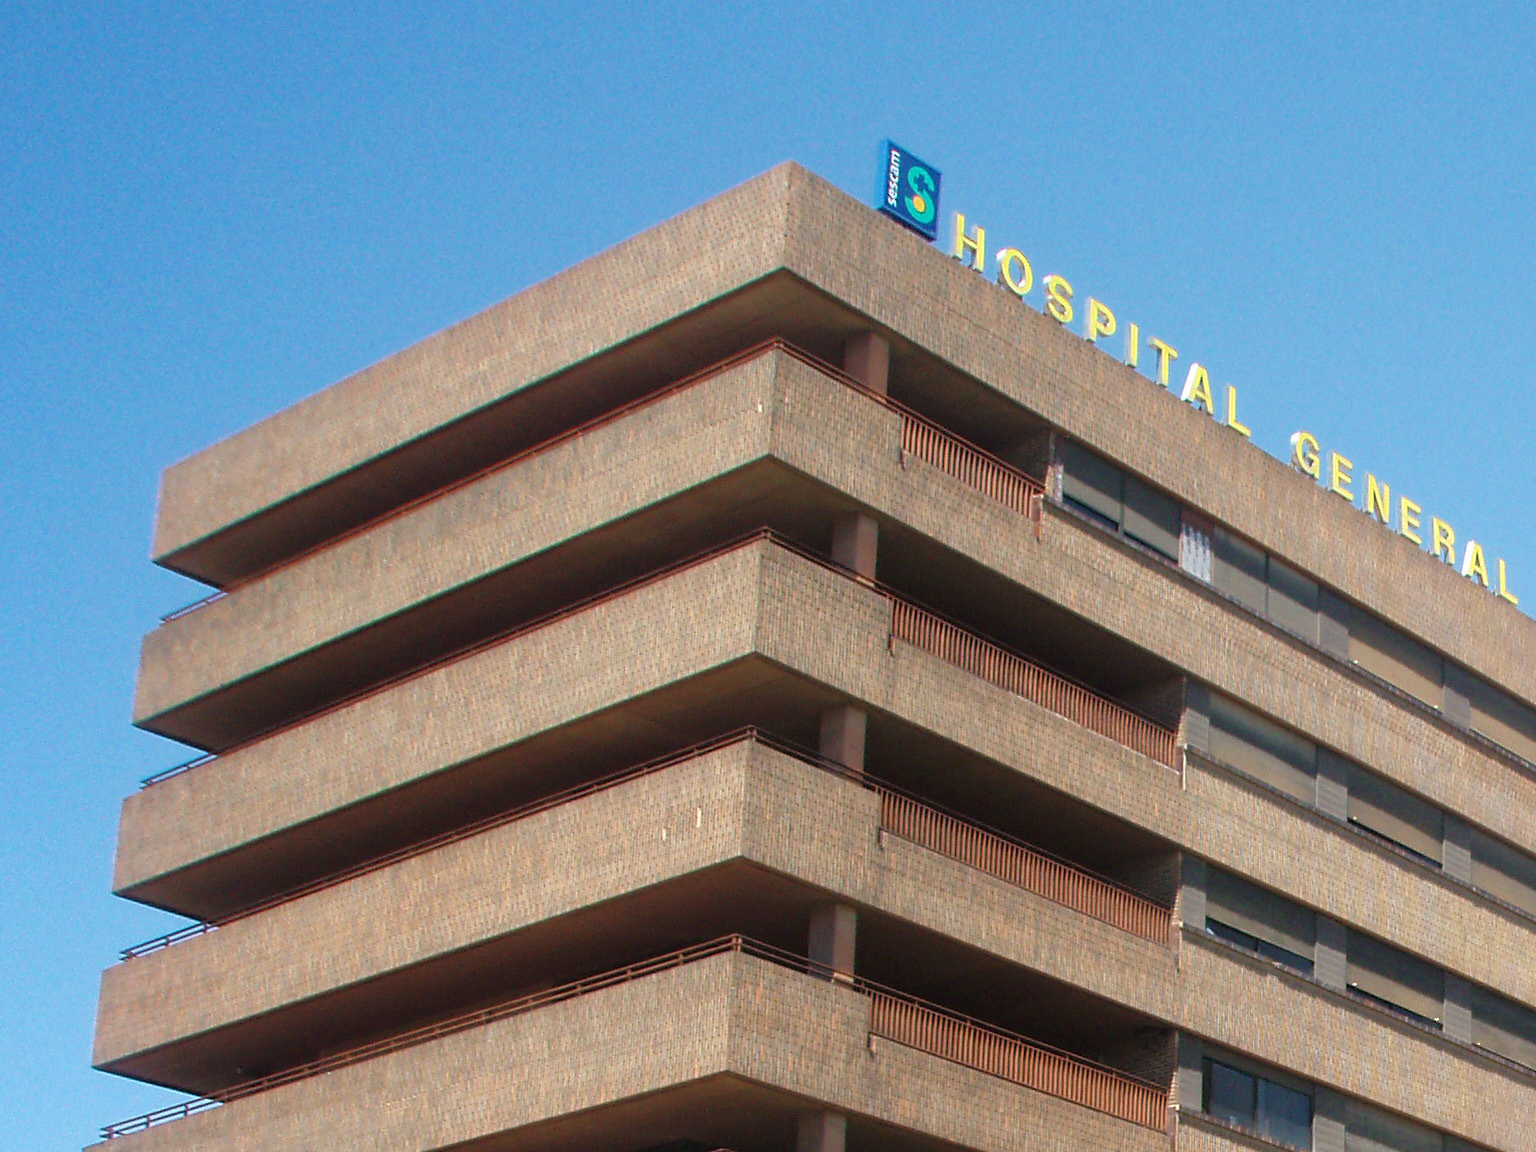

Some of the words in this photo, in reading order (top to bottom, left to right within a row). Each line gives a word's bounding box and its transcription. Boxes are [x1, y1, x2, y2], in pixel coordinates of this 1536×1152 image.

[888, 149, 901, 208] sescam
[951, 212, 1251, 437] HOSPITAL
[1291, 431, 1519, 605] GENERAL
